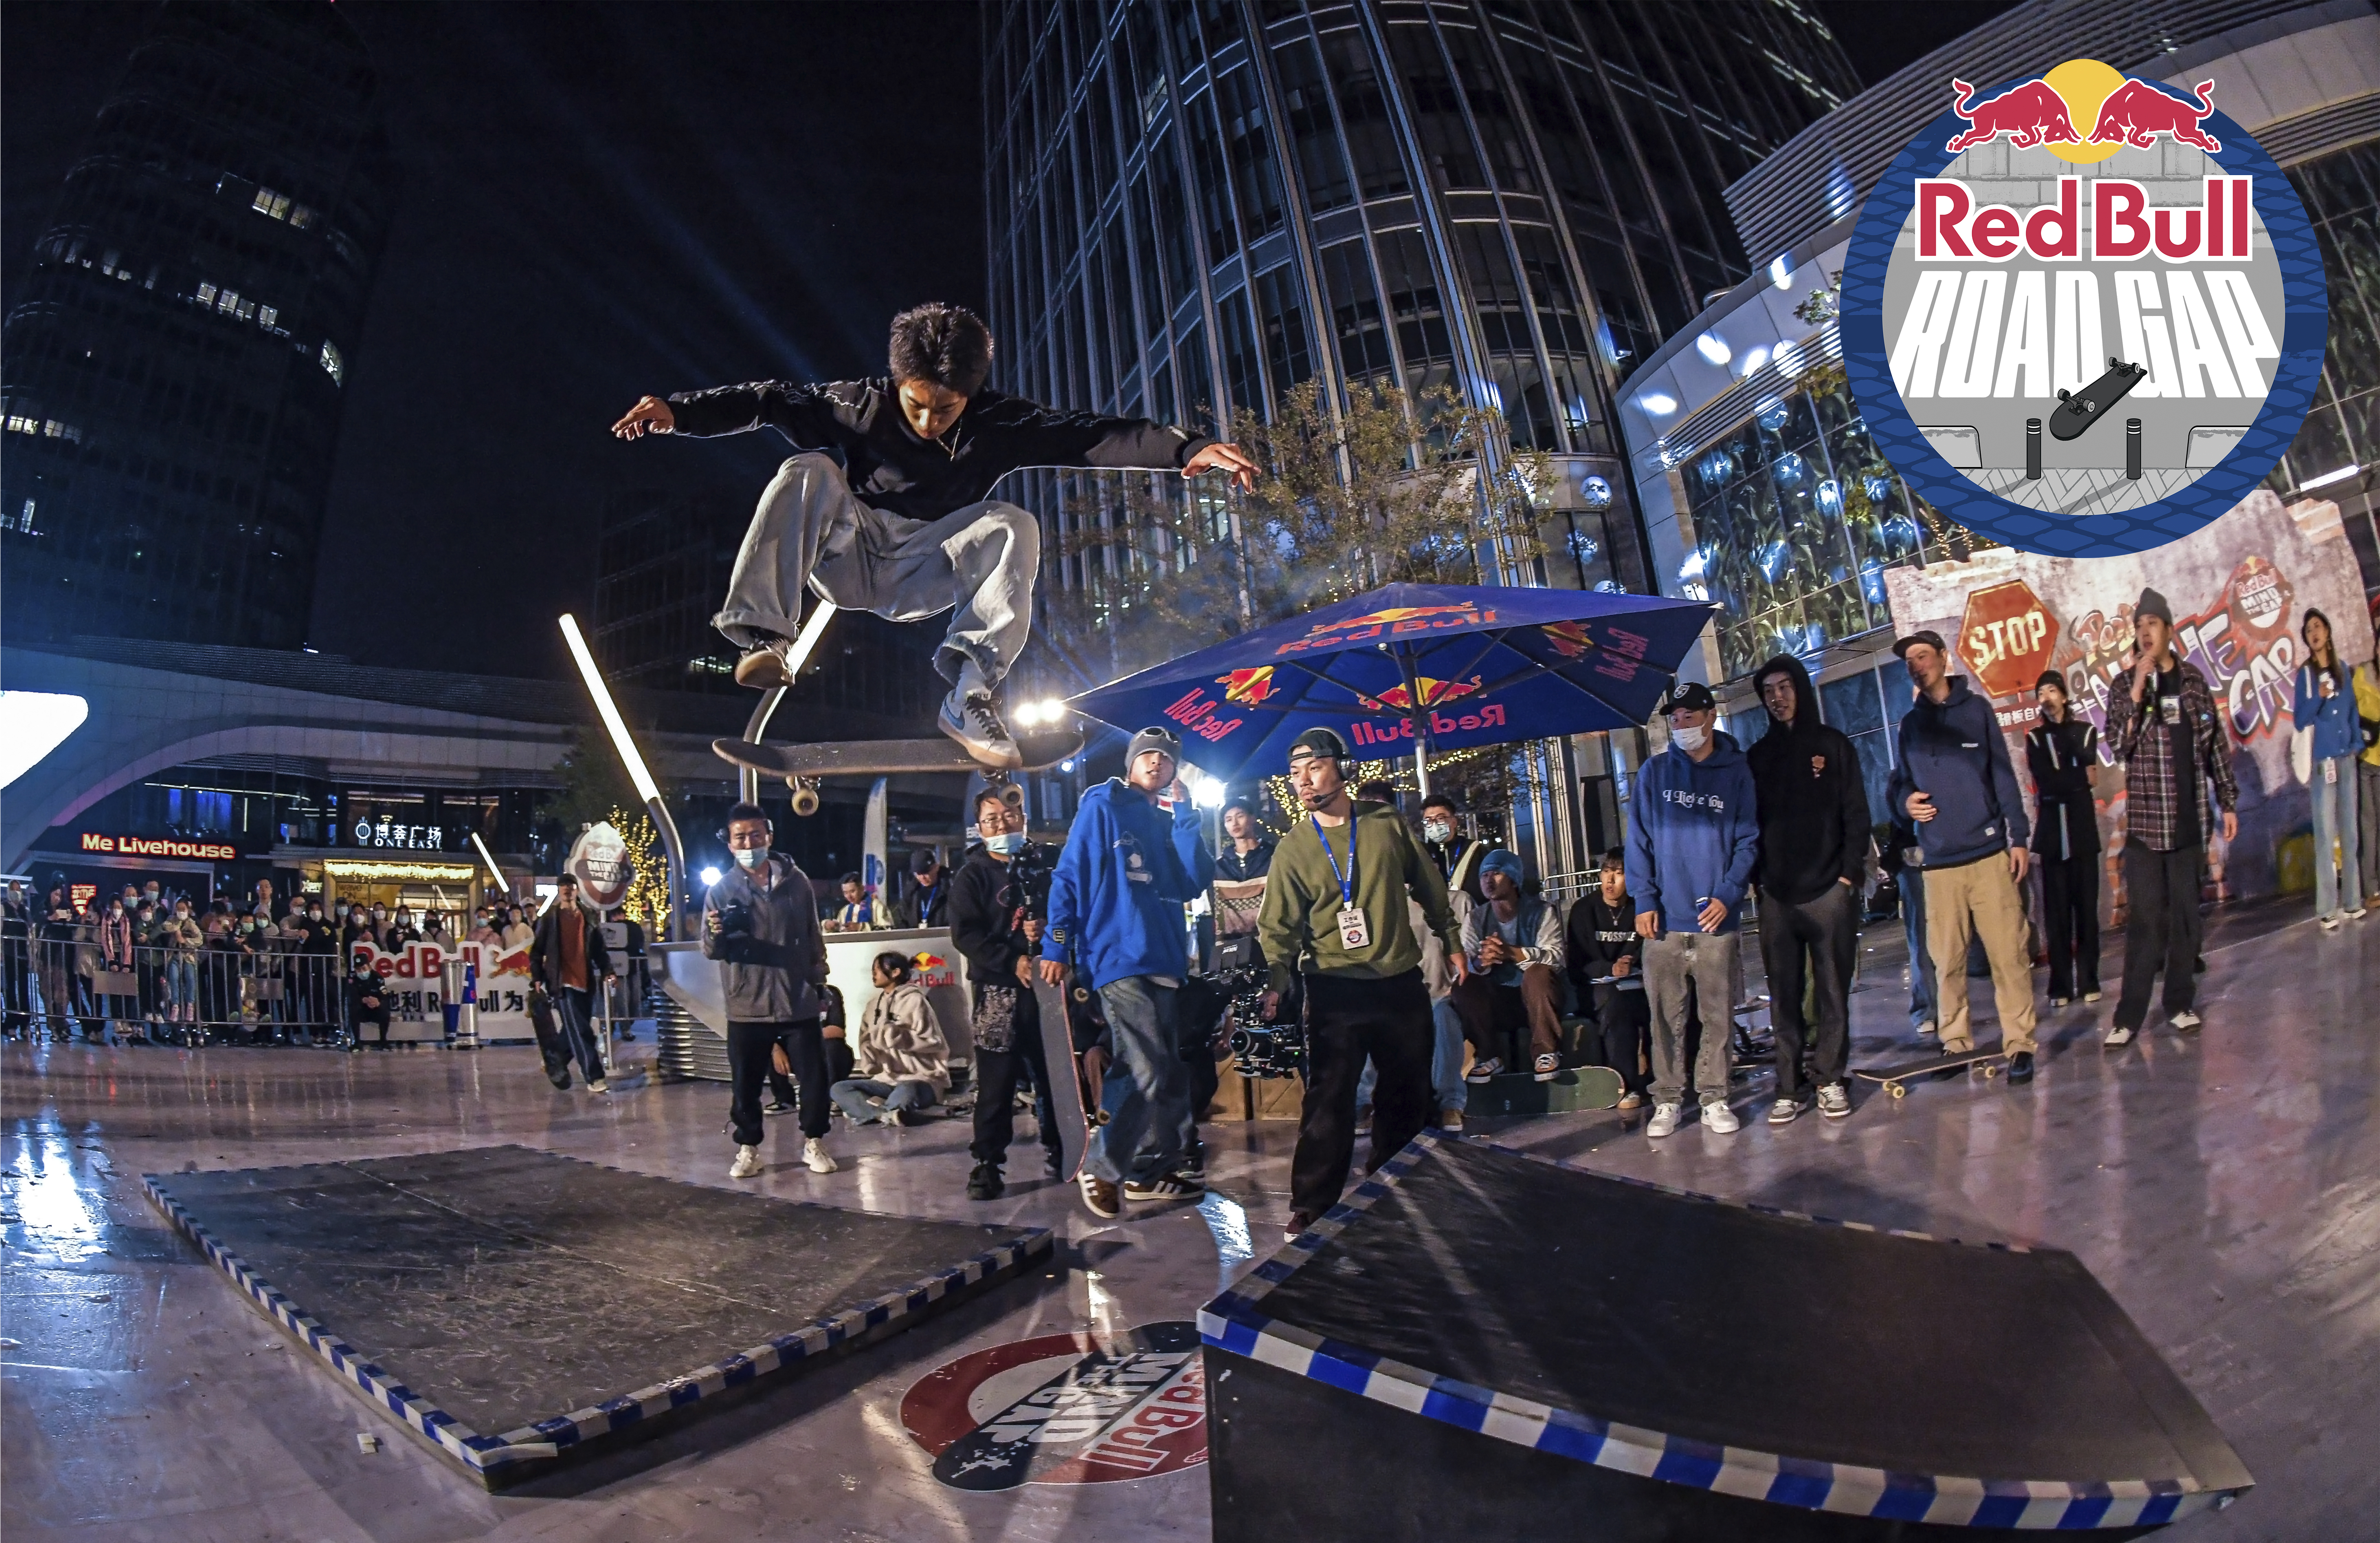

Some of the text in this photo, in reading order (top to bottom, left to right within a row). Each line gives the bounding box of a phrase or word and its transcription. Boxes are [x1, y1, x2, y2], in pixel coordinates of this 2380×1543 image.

[2240, 586, 2279, 609] MIND
[1275, 610, 1497, 656] Red Bull
[1969, 611, 2047, 666] STOP
[2229, 637, 2295, 735] GAP
[82, 833, 236, 859] Me Livehouse
[374, 838, 403, 848] ONE
[421, 946, 481, 978] Bll
[927, 971, 954, 987] Bull
[479, 990, 500, 1013] ull
[1027, 1352, 1192, 1443] MIND
[1087, 1405, 1204, 1471] Bull
